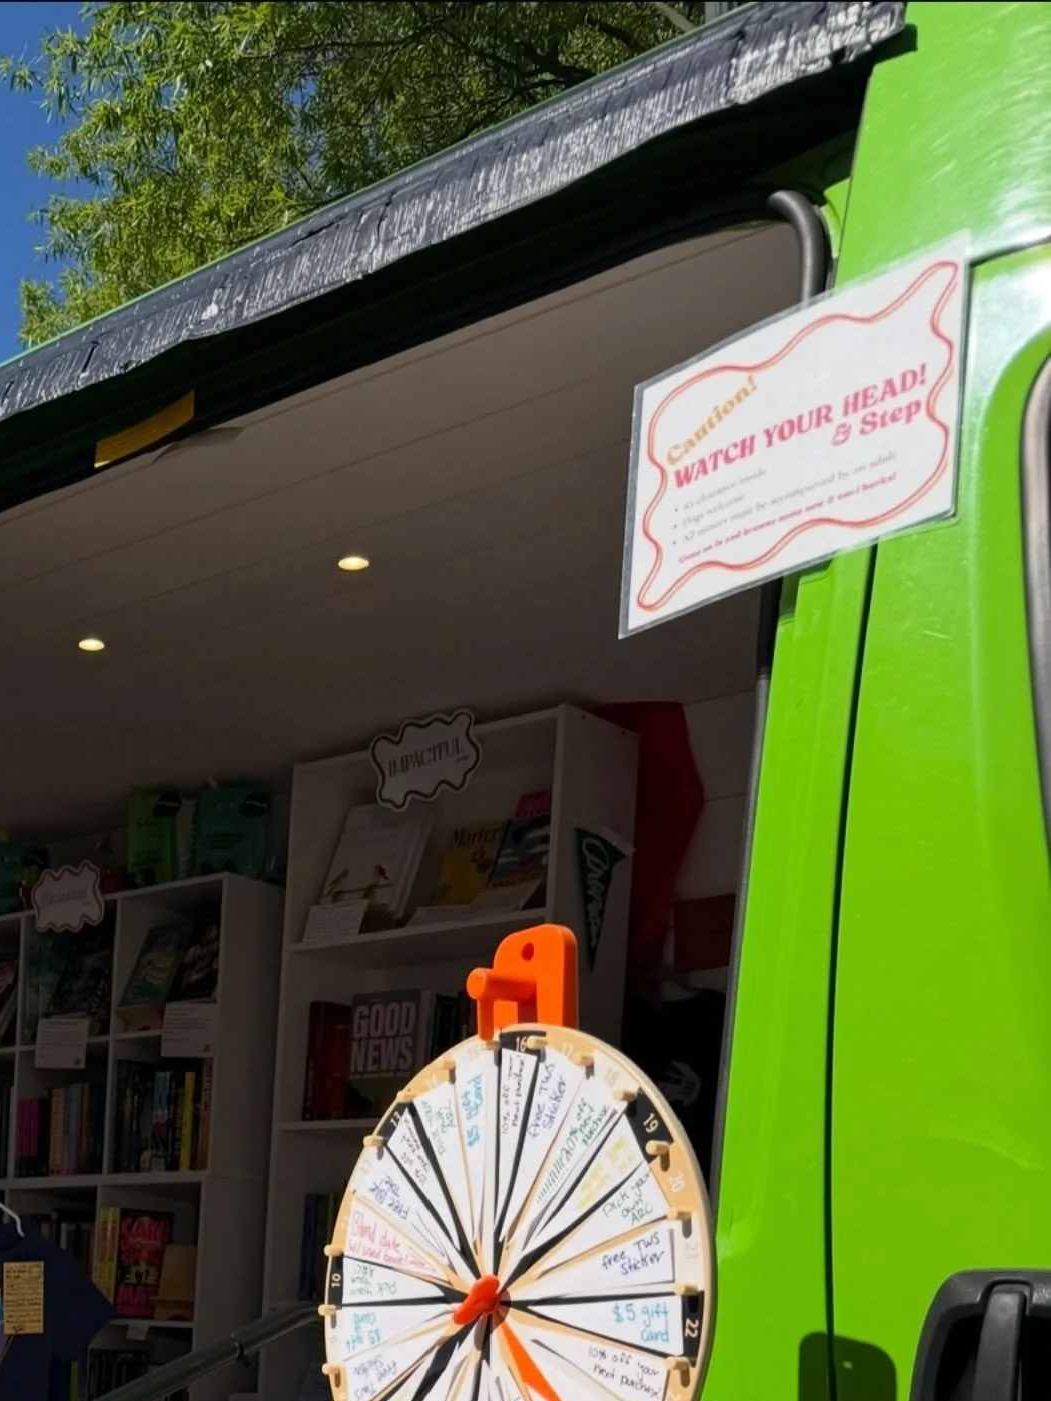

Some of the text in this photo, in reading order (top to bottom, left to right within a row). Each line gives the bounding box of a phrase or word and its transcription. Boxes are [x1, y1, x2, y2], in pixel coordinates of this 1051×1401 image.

[666, 374, 758, 466] Caution!
[674, 363, 927, 488] WATCH YOUR HEAD!
[831, 400, 922, 447] & Step
[683, 494, 746, 527] Dogs welcome
[388, 738, 462, 777] IMPACTFUL
[353, 1001, 417, 1039] GOOD
[350, 1038, 415, 1073] NEWS
[515, 1036, 527, 1053] 16
[538, 1062, 556, 1096] TWS
[465, 1125, 480, 1148] $5
[642, 1112, 659, 1134] 19
[631, 1206, 653, 1226] ARC
[634, 1231, 661, 1253] TWS
[331, 1273, 342, 1288] 10
[613, 1302, 669, 1328] $5 gift
[684, 1318, 699, 1338] 22
[588, 1346, 660, 1381] 10% off your
[593, 1363, 616, 1379] next
